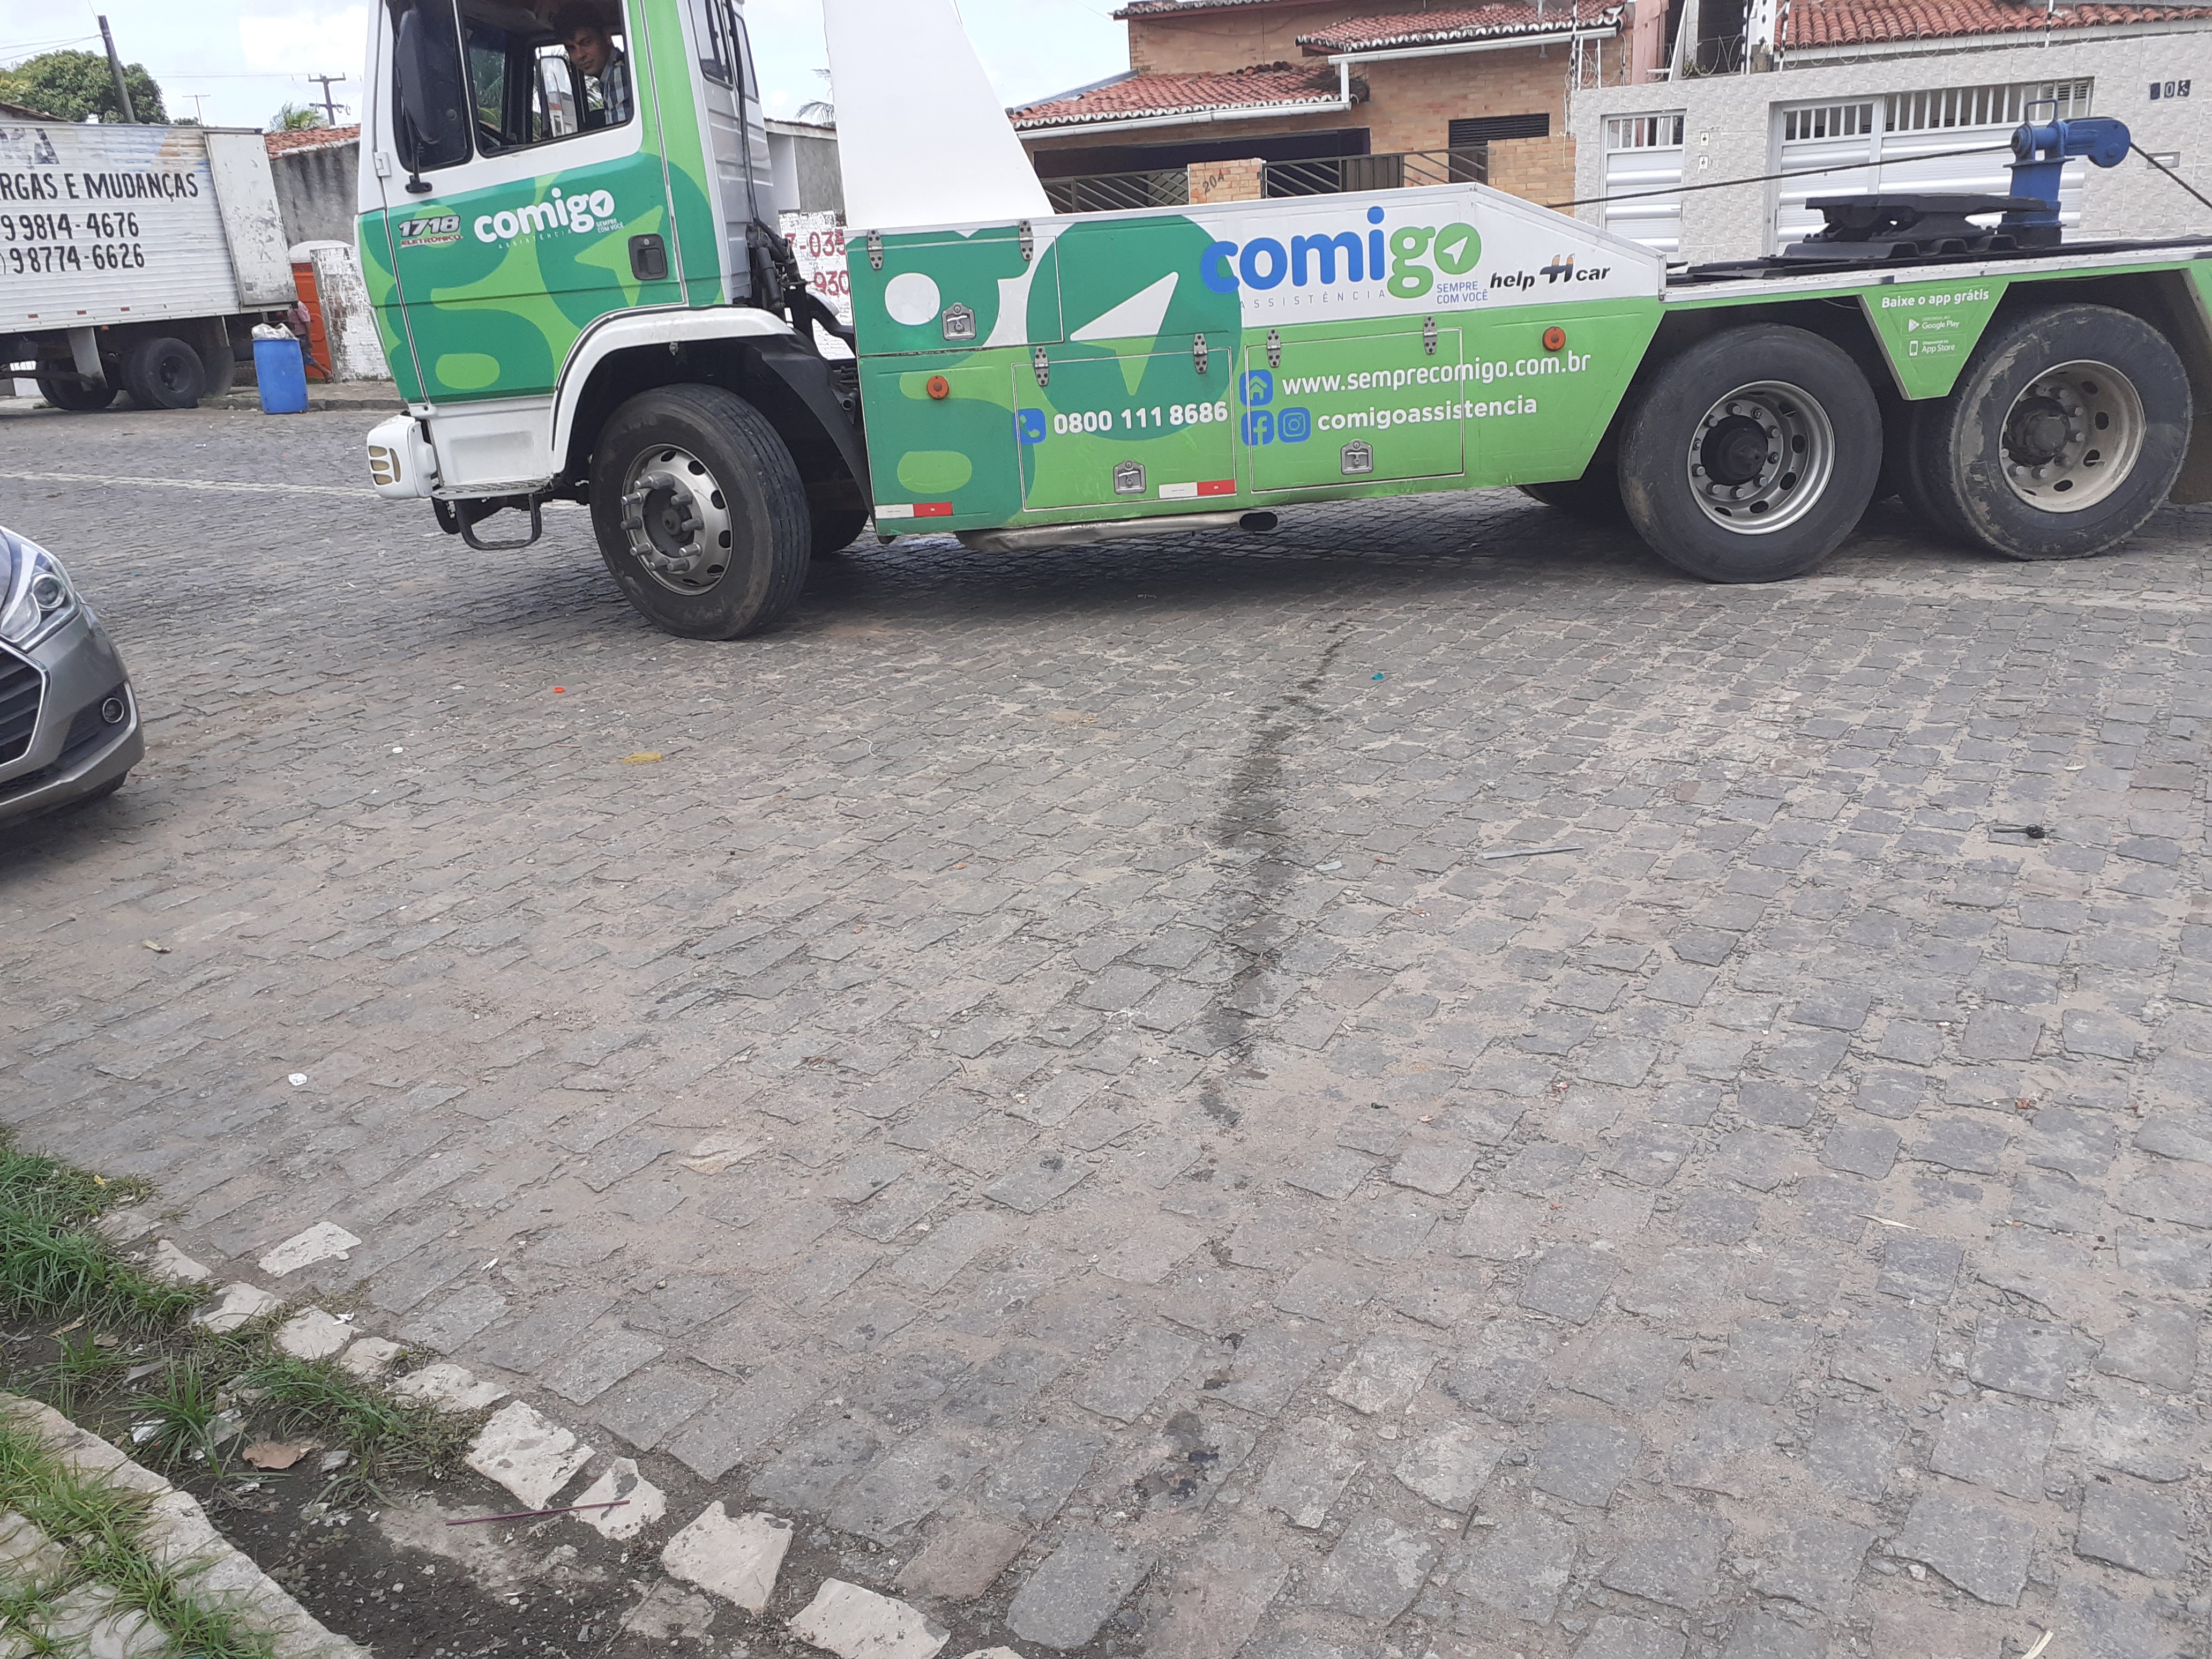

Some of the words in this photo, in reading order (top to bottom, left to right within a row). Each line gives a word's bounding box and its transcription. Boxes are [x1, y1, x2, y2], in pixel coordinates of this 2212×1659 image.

[0, 173, 58, 200] RGAS
[64, 173, 80, 199] E
[83, 173, 198, 202] MUDANÇAS
[398, 215, 460, 237] 1718
[474, 188, 615, 243] comigo
[1201, 206, 1482, 298] comigo
[1437, 281, 1478, 293] SEMPRE
[1490, 271, 1535, 292] help
[1576, 267, 1611, 281] car
[1240, 289, 1385, 309] ASSISTÊNCIA
[1437, 294, 1460, 304] COM
[1462, 288, 1489, 302] VOCÊ
[1881, 296, 1915, 308] Baixe
[1918, 296, 1925, 305] o
[1929, 294, 1951, 306] app
[1954, 289, 1989, 304] grátis
[1922, 321, 1946, 330] Google
[1946, 320, 1960, 328] Play
[1922, 345, 1937, 354] App
[1937, 344, 1955, 352] Store
[1282, 350, 1591, 395] www.semprecomigo.com.br
[1053, 410, 1112, 435] 0800
[1121, 407, 1162, 429] 111
[1169, 401, 1228, 425] 8686
[1317, 395, 1537, 430] comigoassistencia
